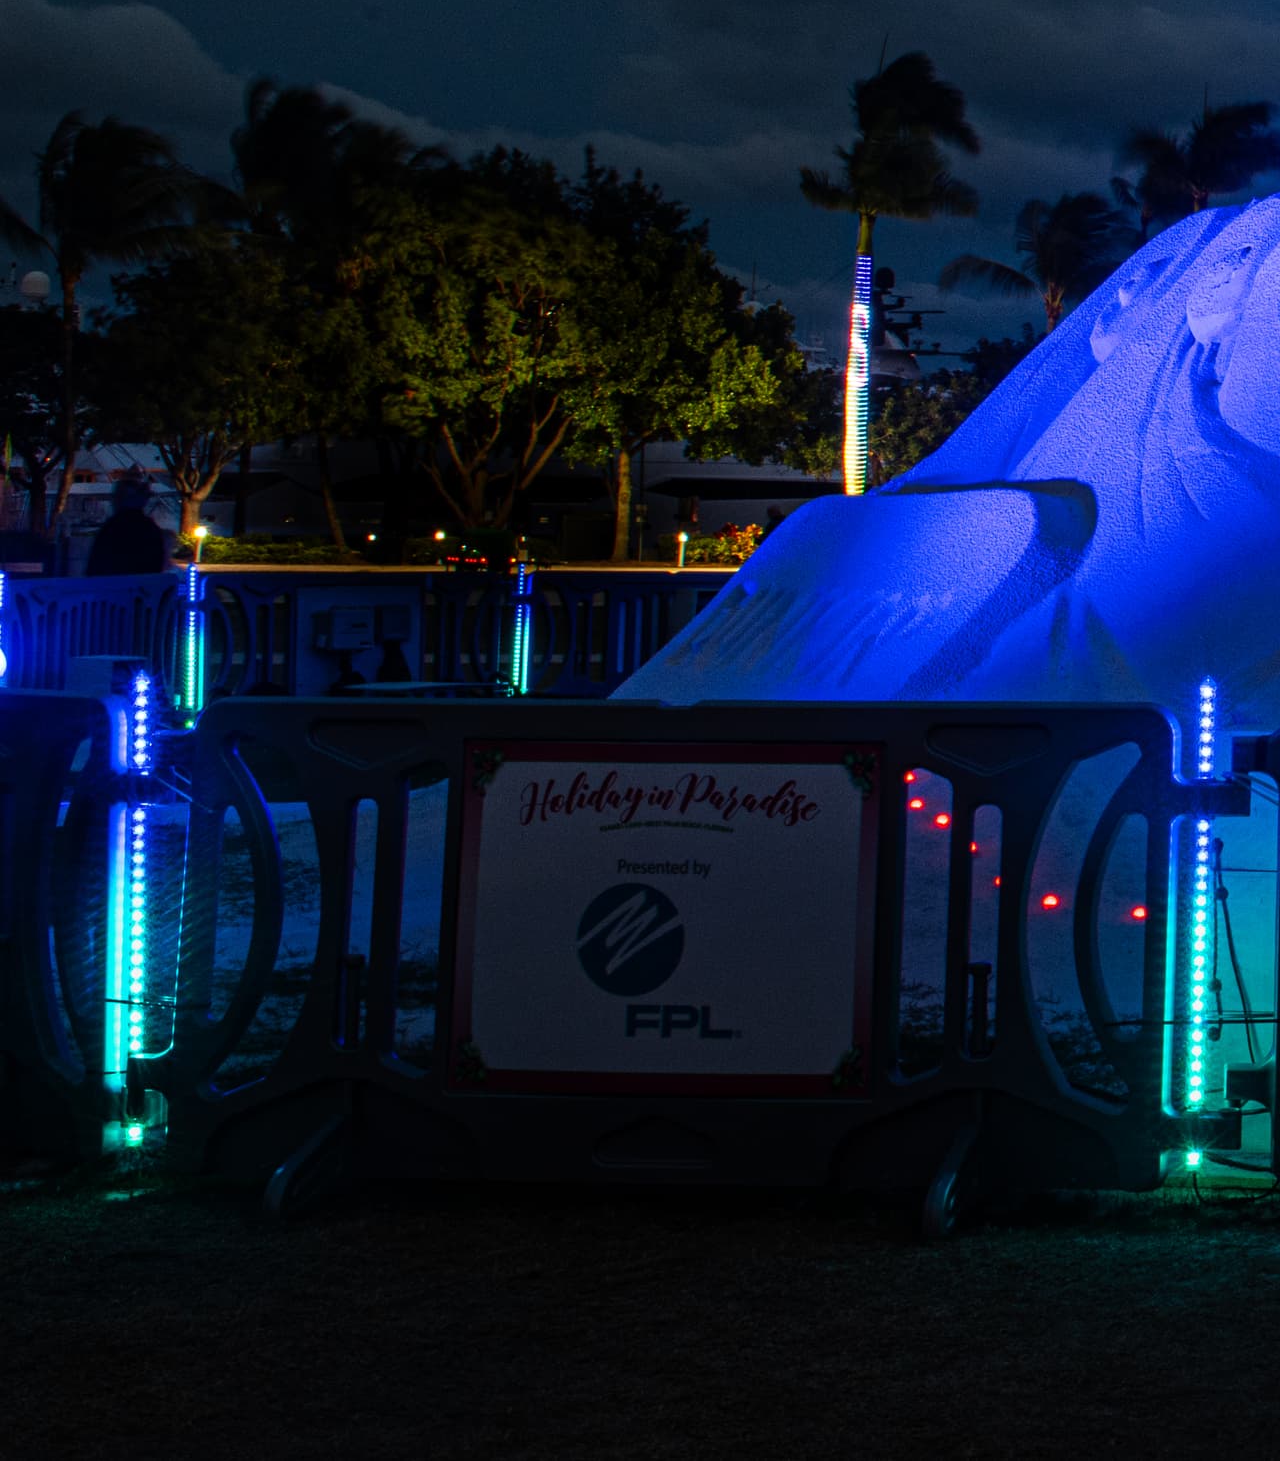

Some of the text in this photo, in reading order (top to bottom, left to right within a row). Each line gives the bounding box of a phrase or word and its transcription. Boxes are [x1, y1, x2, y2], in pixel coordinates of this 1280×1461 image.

[520, 770, 821, 826] Holiday in Paradise
[618, 859, 711, 878] Presented by
[626, 1004, 734, 1039] FPL
